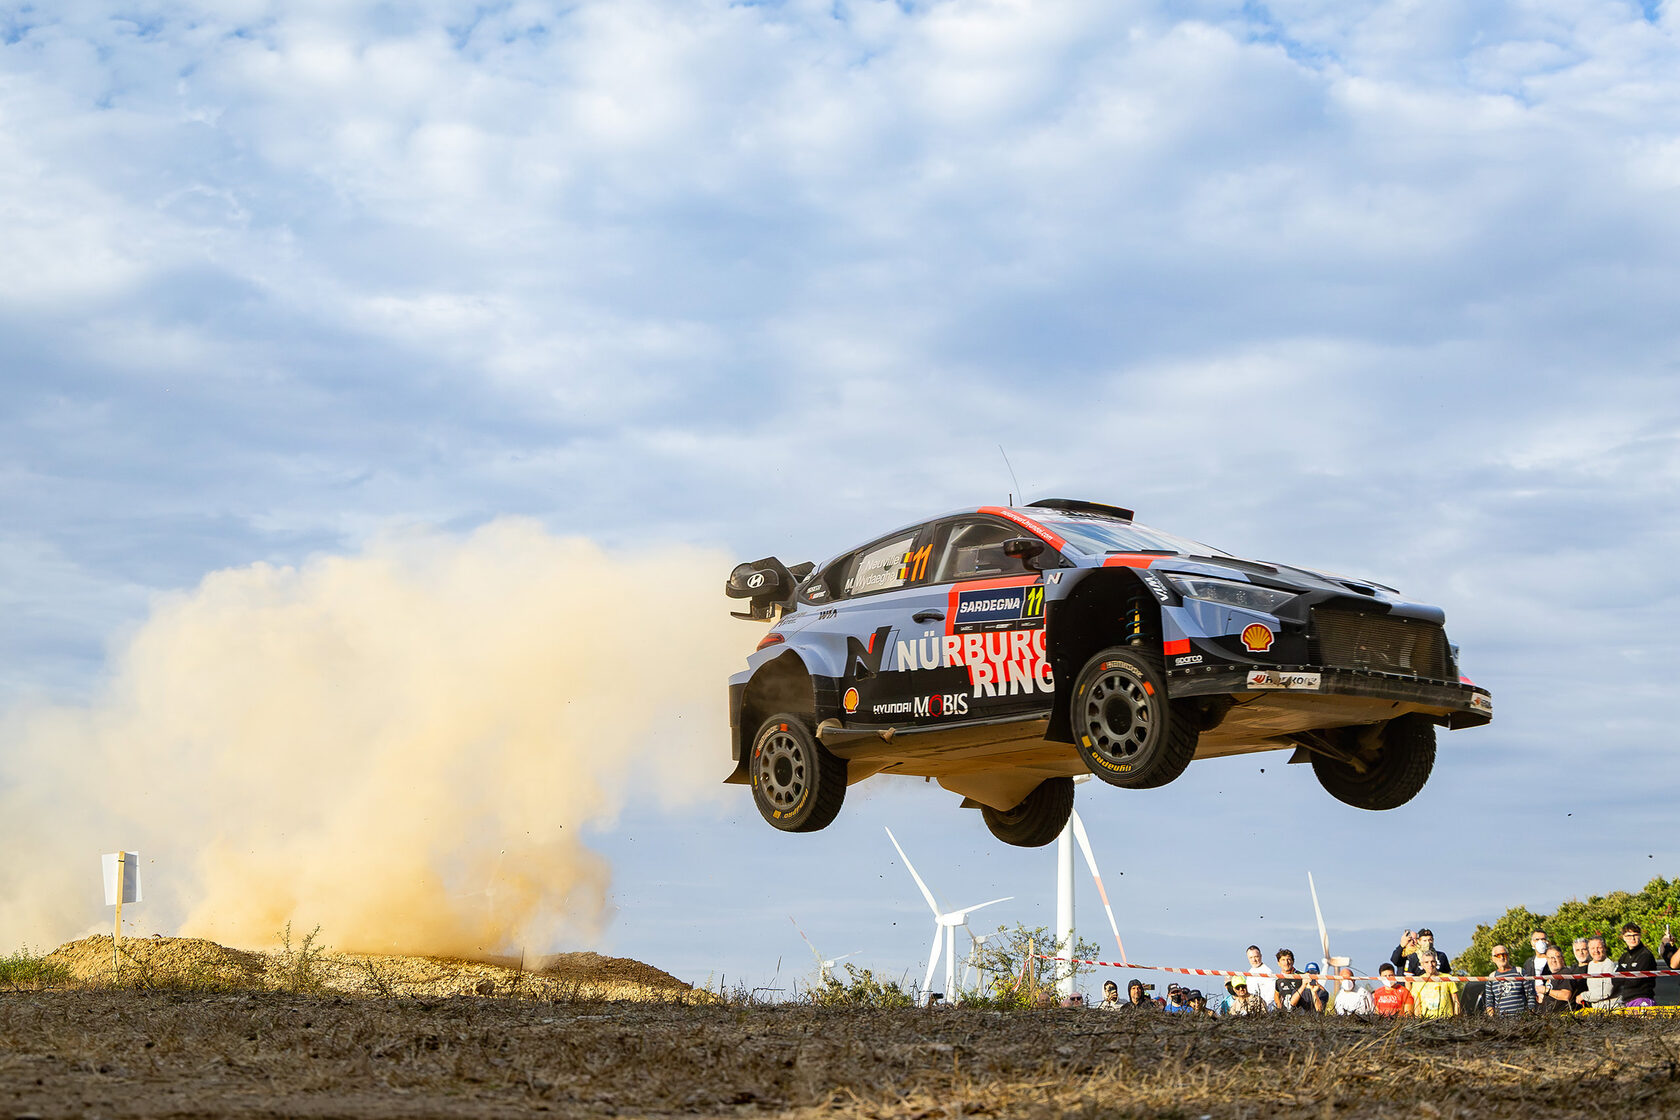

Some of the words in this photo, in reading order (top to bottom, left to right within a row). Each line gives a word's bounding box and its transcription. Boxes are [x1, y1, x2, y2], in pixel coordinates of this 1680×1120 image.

[910, 543, 934, 582] 11
[959, 597, 1020, 614] SARDEGNA
[1027, 586, 1044, 616] 11
[973, 658, 1056, 699] RING
[873, 702, 912, 715] HYUNDAI
[913, 692, 969, 718] MOBIS
